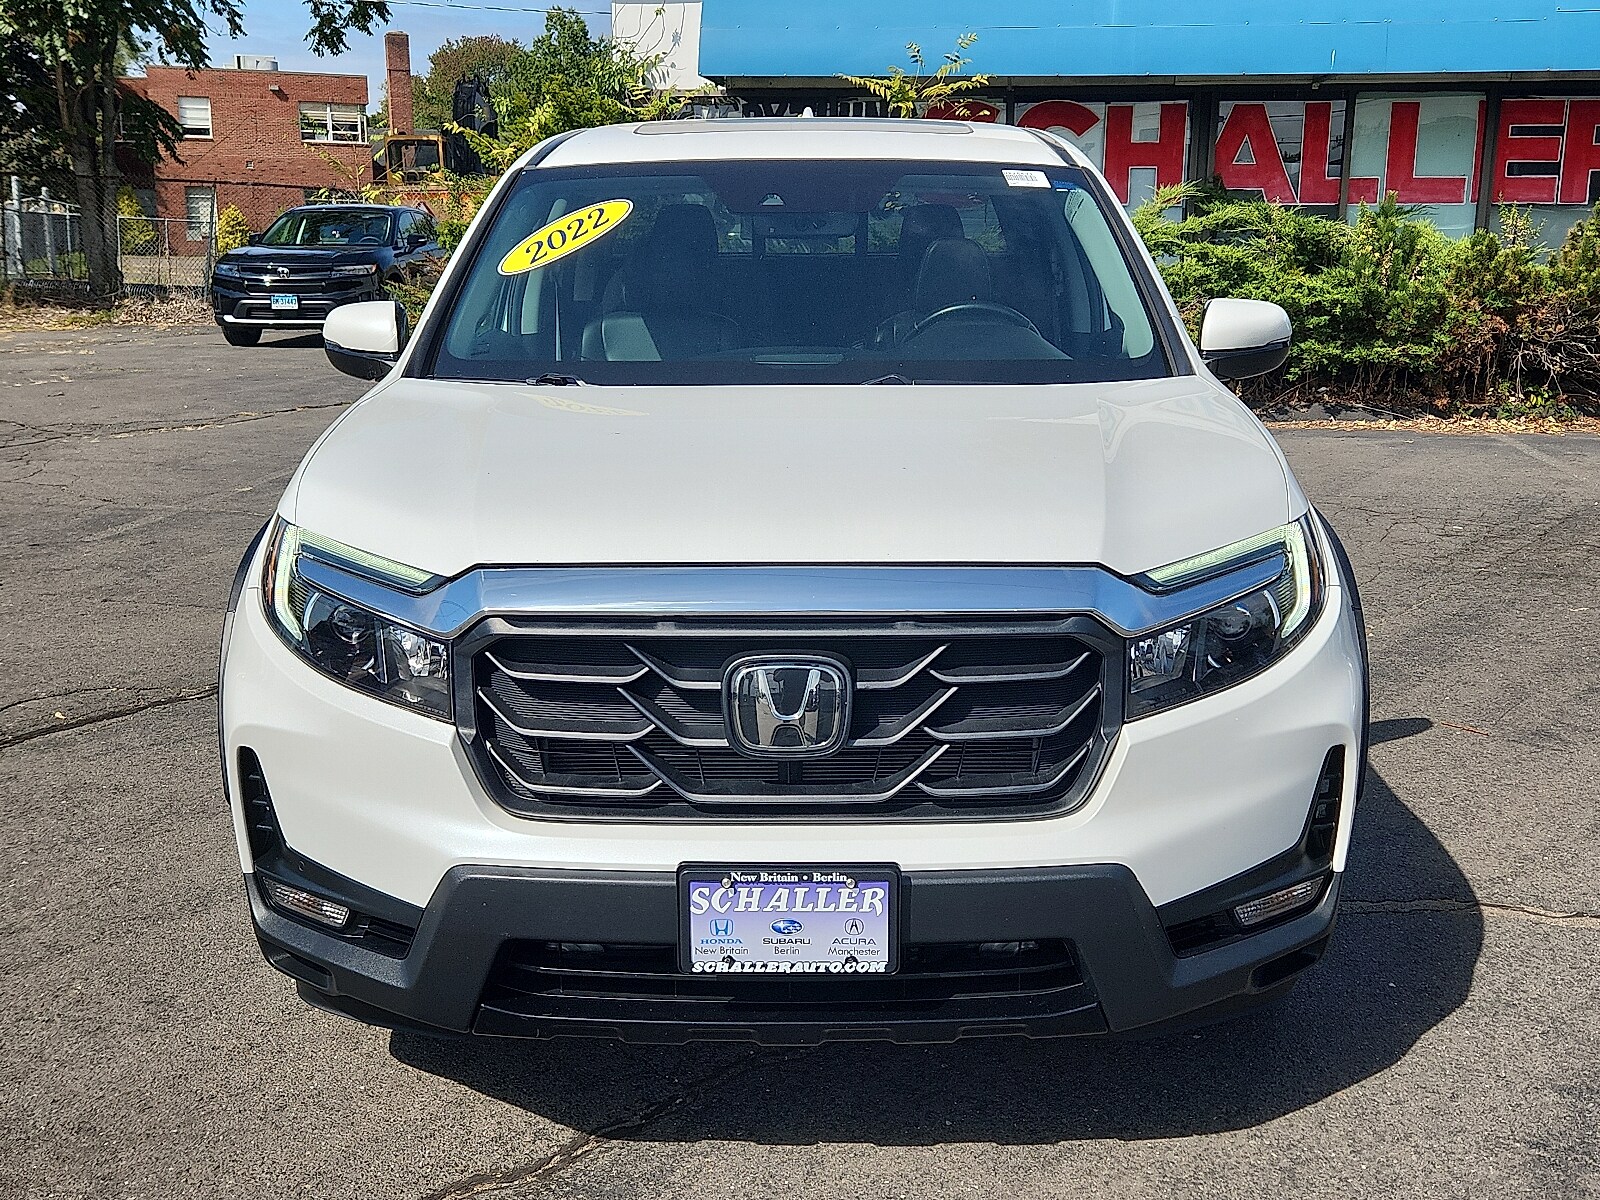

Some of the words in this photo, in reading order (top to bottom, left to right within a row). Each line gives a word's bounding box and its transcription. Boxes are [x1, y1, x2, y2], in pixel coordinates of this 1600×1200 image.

[930, 98, 1600, 207] HALLE
[525, 207, 610, 265] 2022
[730, 872, 757, 882] New
[759, 872, 799, 882] Britain
[812, 872, 848, 882] Berlin
[690, 886, 885, 917] SCHALLER
[694, 946, 717, 955] New
[719, 946, 749, 955] Britain
[774, 946, 800, 955] Berlin
[828, 946, 881, 956] Manchester
[691, 961, 888, 974] SCHALLERAUTO.COM
